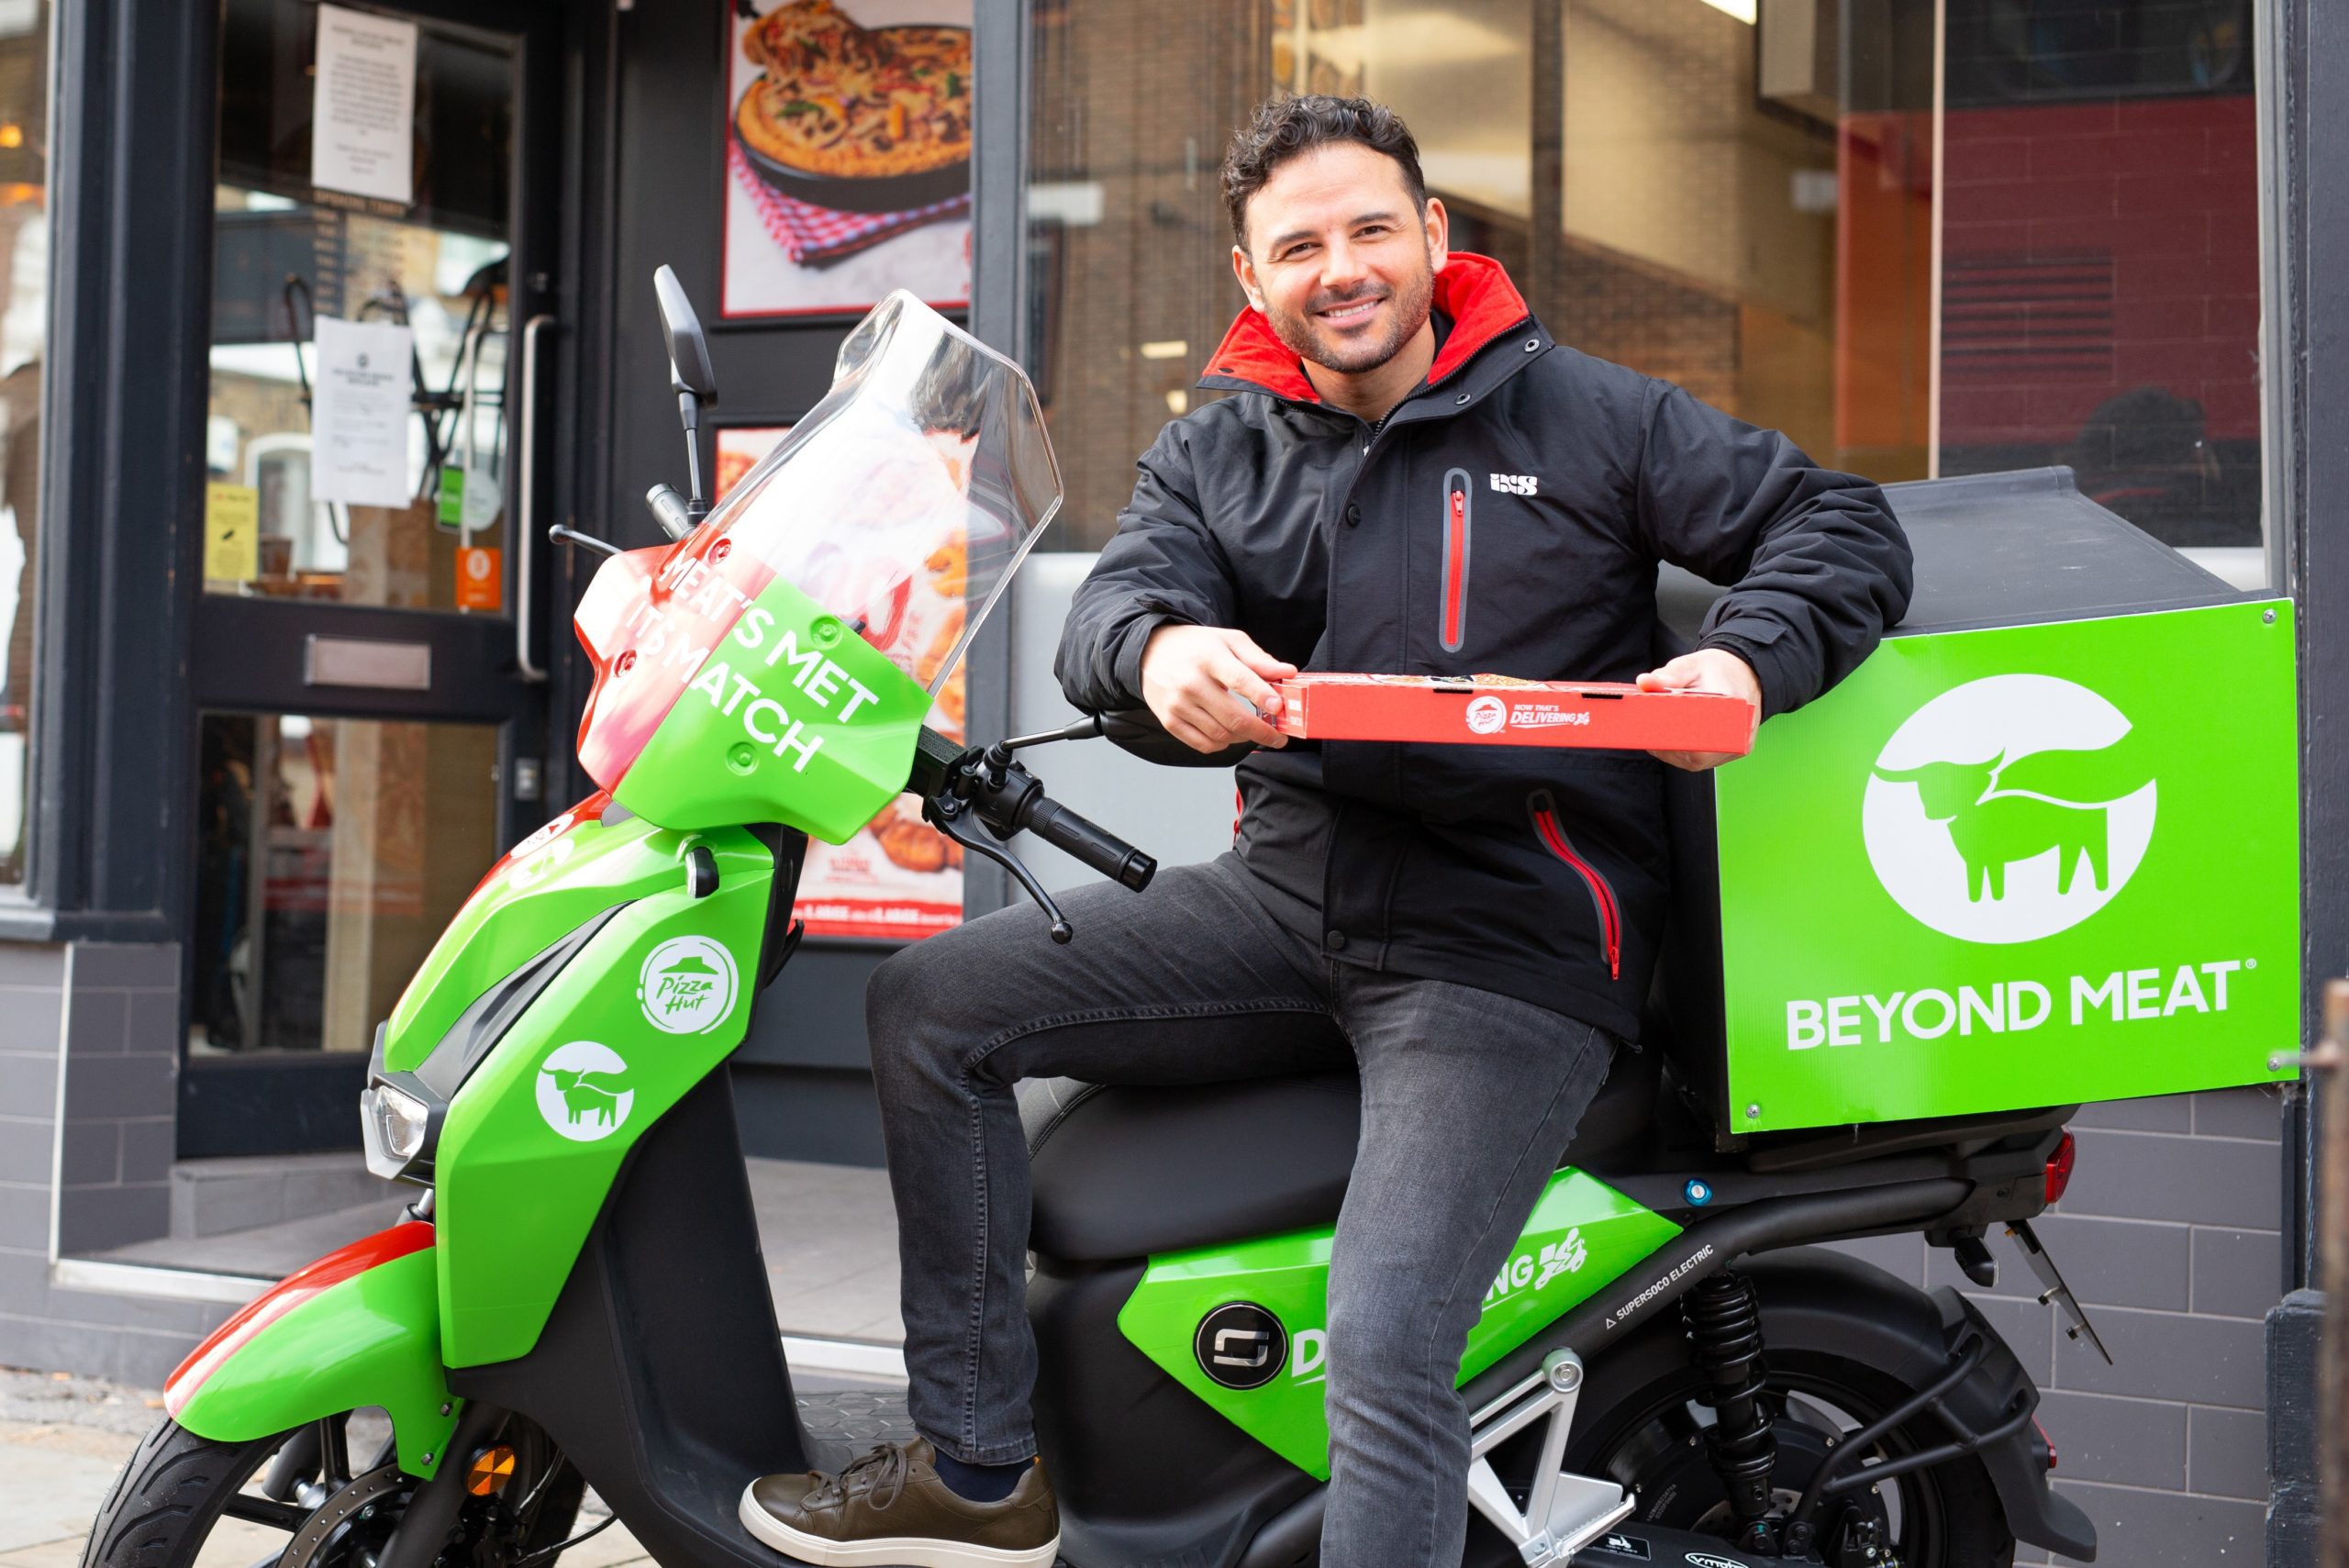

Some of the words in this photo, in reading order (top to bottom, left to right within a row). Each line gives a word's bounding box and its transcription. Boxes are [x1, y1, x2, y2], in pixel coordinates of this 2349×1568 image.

[658, 550, 775, 649] MEAT'S
[764, 629, 880, 724] MET
[662, 632, 825, 773] MATCH
[1509, 711, 1576, 725] DELIVERING
[1535, 704, 1559, 712] THAT'S
[656, 974, 714, 999] Pizza
[665, 994, 711, 1015] Hut
[1787, 980, 2052, 1051] BEYOND
[1616, 1276, 1670, 1320] SUPERSOCO
[1669, 1244, 1714, 1282] ELECTRIC
